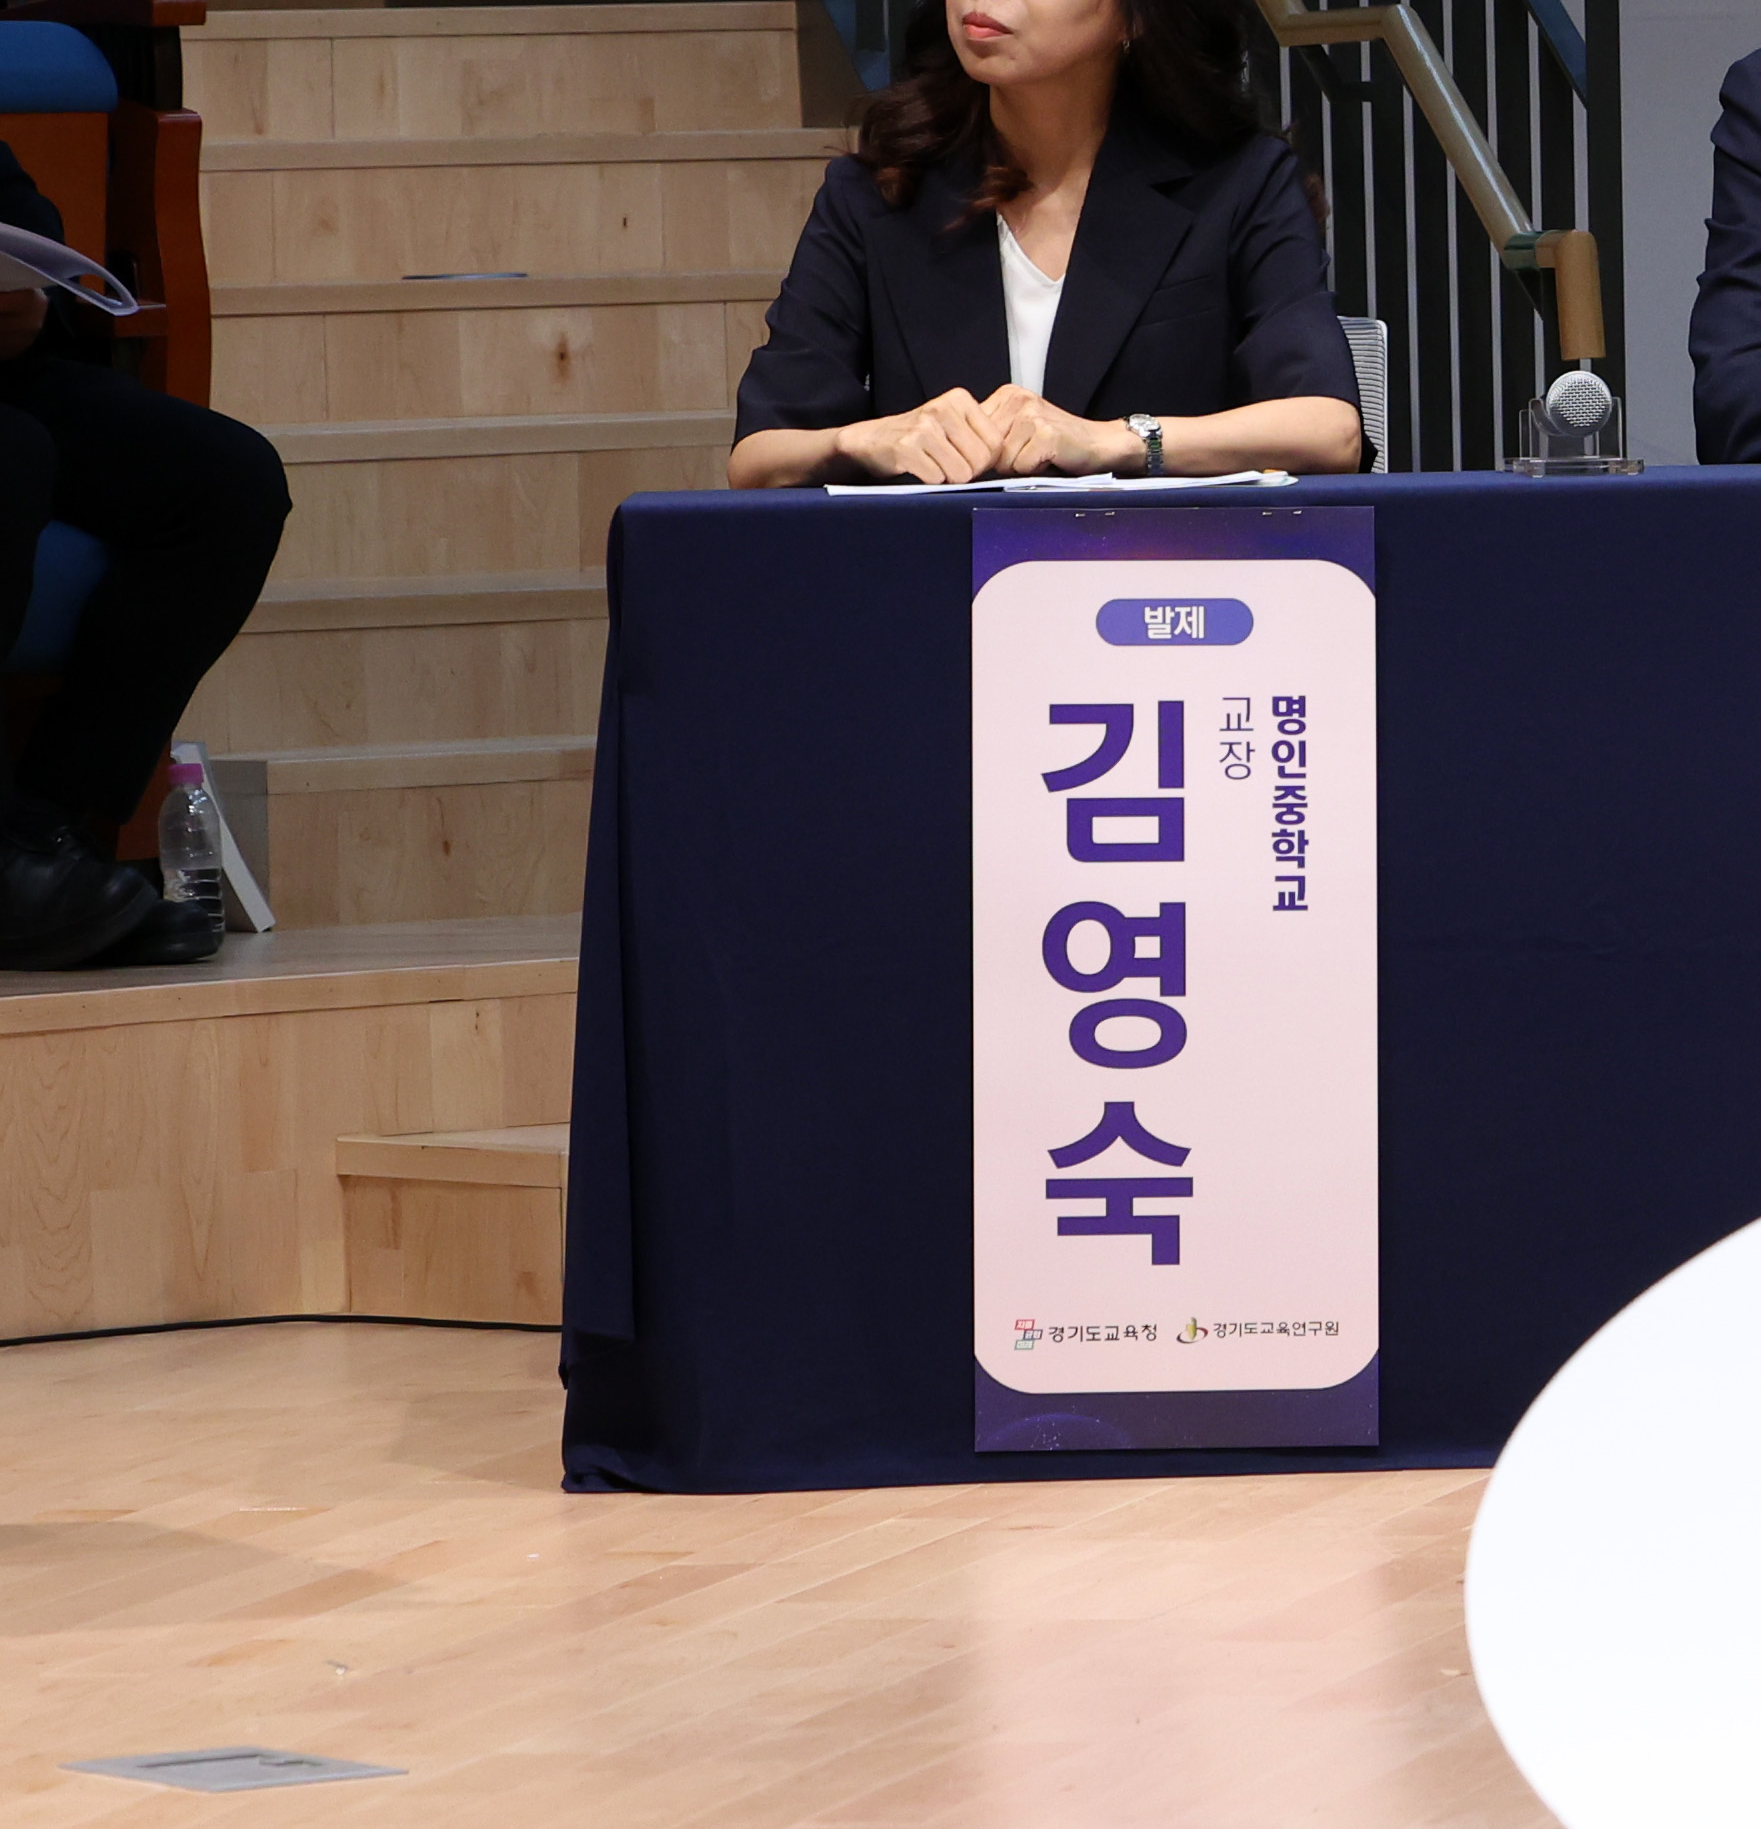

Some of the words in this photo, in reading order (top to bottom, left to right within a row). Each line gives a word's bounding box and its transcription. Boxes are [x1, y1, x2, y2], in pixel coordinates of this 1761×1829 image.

[1143, 605, 1205, 640] 발제
[1219, 697, 1256, 780] 교장
[1272, 694, 1308, 913] 명인중학교
[1040, 700, 1194, 1266] 김영숙
[1049, 1324, 1158, 1343] 경기도교육청
[1213, 1321, 1340, 1339] 경기도교육연구원
